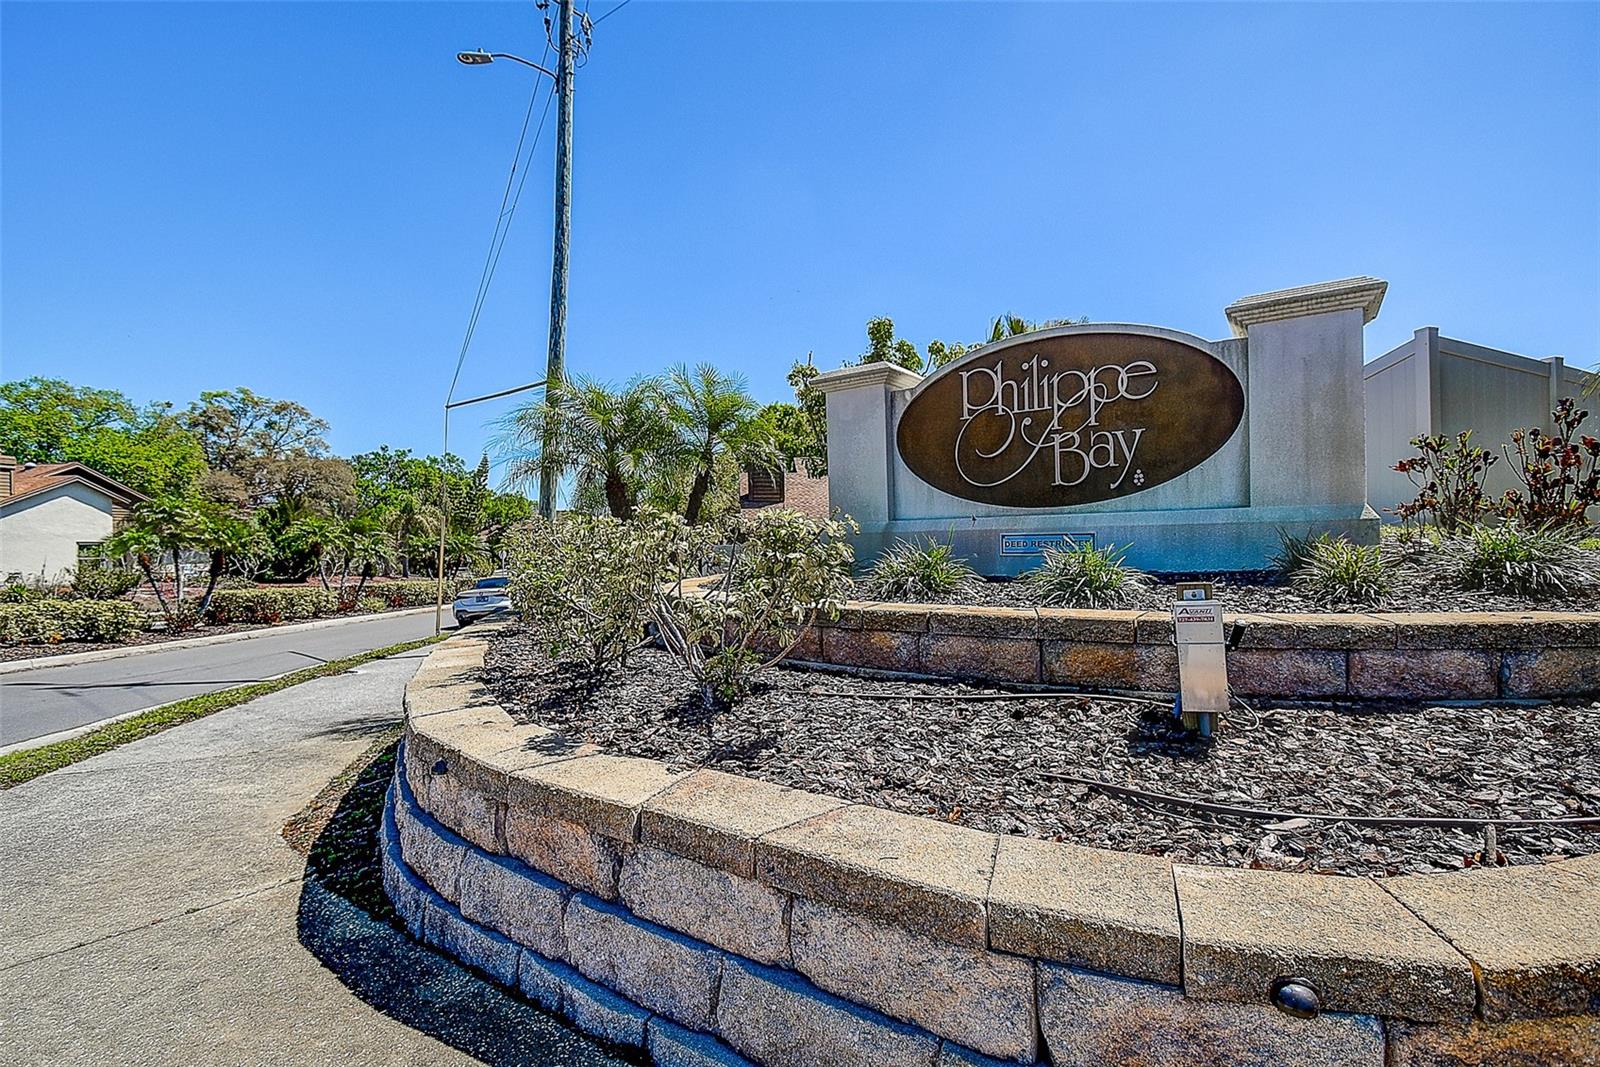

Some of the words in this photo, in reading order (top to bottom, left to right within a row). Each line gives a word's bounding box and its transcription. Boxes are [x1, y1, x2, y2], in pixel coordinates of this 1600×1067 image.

[957, 353, 1159, 431] Philippe
[1051, 428, 1146, 490] Bay
[1005, 540, 1028, 548] DEED
